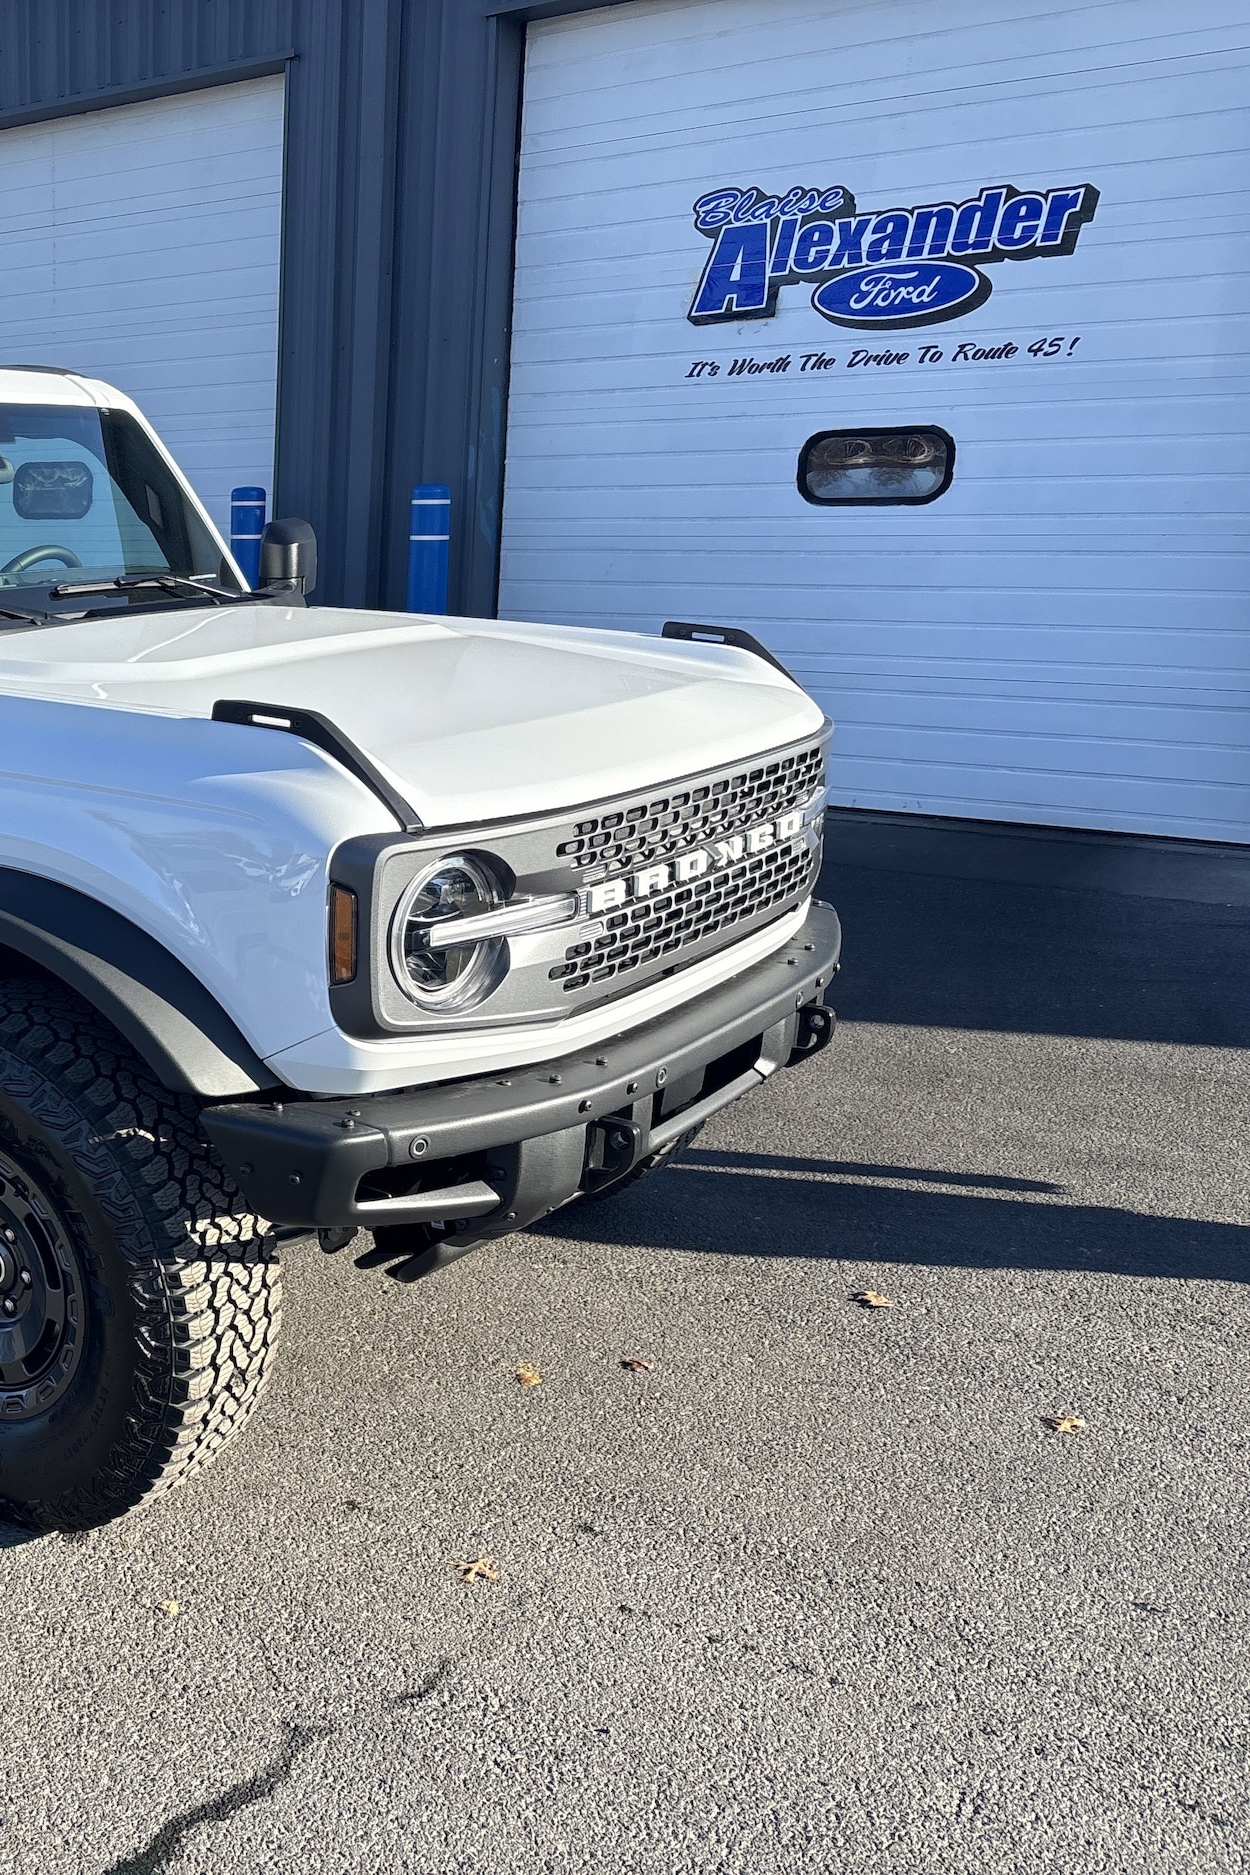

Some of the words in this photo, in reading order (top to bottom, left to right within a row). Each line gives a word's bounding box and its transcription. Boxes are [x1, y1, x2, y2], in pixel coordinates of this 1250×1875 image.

[694, 184, 846, 229] Blaise
[690, 183, 1094, 318] Alexander
[849, 272, 940, 310] Ford
[684, 360, 721, 378] It's
[727, 355, 791, 377] Worth
[799, 353, 836, 372] The
[846, 347, 910, 369] Drive
[918, 345, 944, 364] To
[952, 340, 1019, 362] Route
[586, 809, 802, 915] BRONCO
